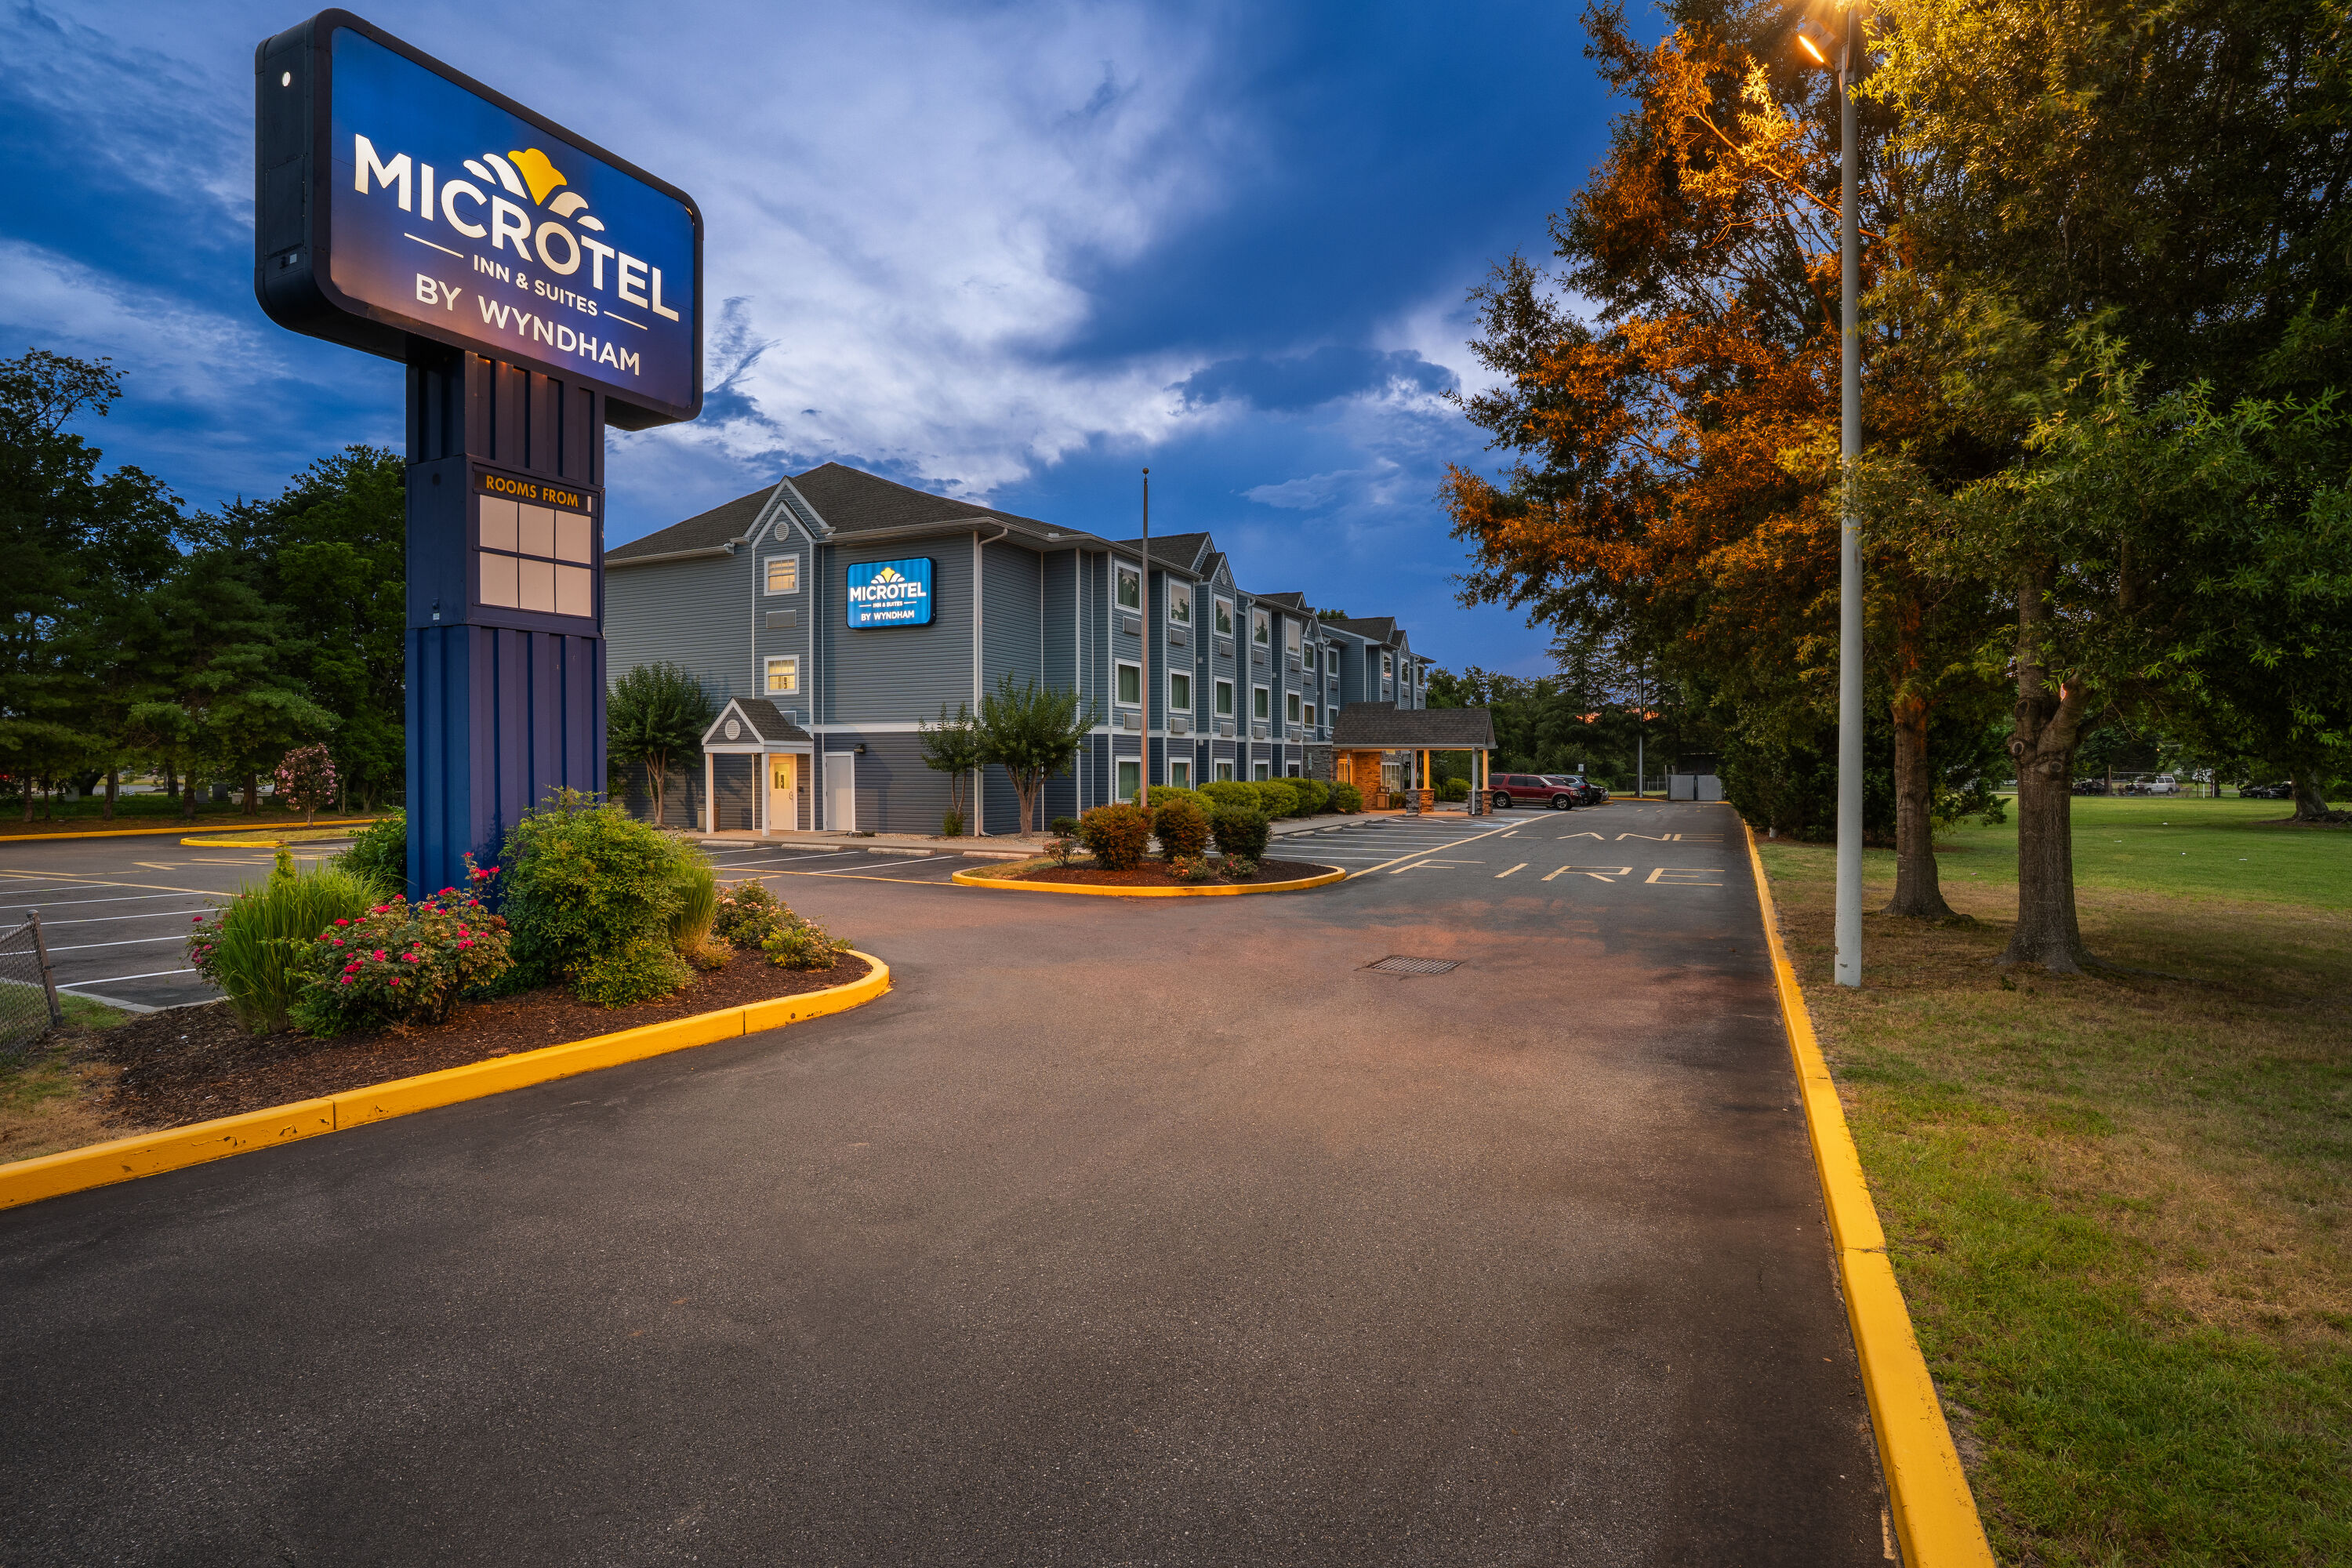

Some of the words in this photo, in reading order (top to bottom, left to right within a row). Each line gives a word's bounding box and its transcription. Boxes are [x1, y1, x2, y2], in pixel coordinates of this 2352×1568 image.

[354, 133, 679, 321] MICROTEL
[473, 254, 510, 285] INN
[515, 272, 529, 290] &
[534, 279, 598, 317] SUITES
[416, 273, 462, 311] BY
[477, 295, 640, 376] WYNDHAM
[486, 474, 536, 499] ROOMS
[543, 488, 579, 508] FROM
[850, 582, 927, 602] MICROTEL
[861, 613, 871, 622] BY
[873, 610, 915, 620] WYNDHAM
[1501, 830, 1725, 842] LANE
[1388, 859, 1725, 886] FIRE
